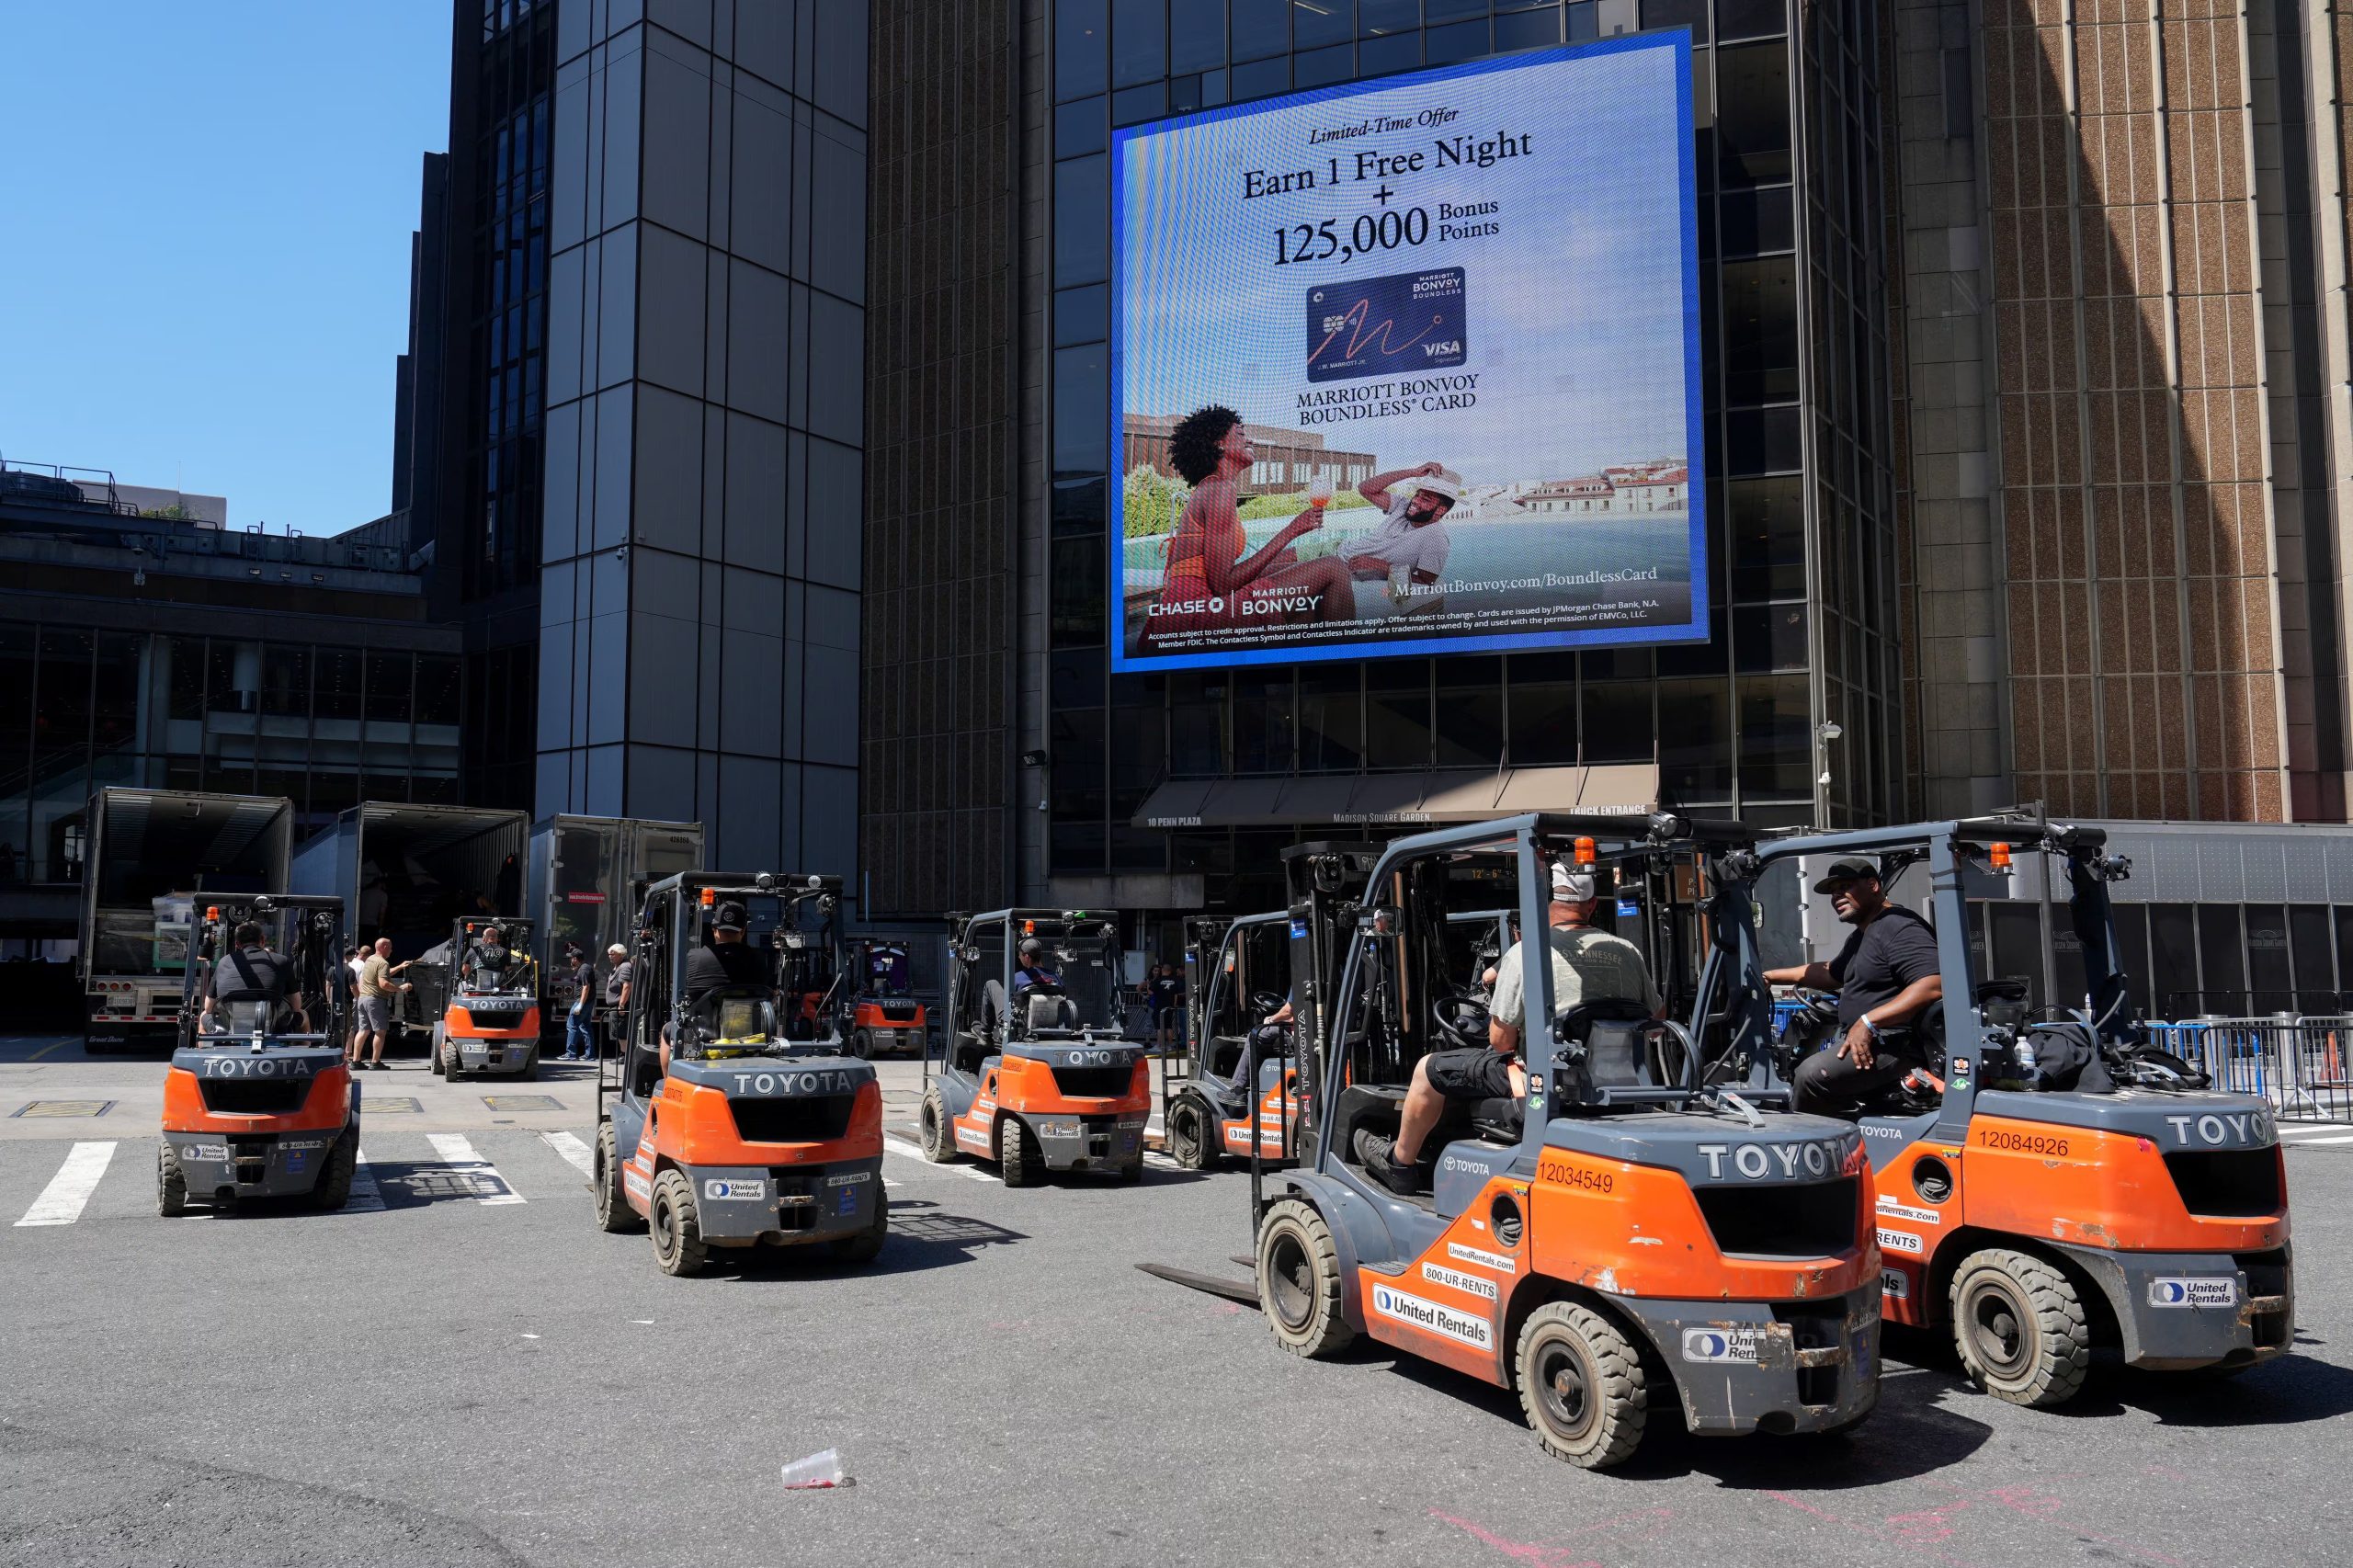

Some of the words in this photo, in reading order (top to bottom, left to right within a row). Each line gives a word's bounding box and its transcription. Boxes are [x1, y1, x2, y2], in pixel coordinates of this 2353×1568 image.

[1309, 117, 1412, 144] Limited-Time
[1418, 108, 1460, 128] Offer
[1243, 169, 1315, 199] Earn
[1328, 158, 1339, 185] 1
[1355, 151, 1424, 180] Free
[1435, 131, 1532, 168] Night
[1438, 201, 1499, 221] Bonus
[1274, 207, 1429, 265] 125,000
[1438, 221, 1500, 242] Points
[1413, 278, 1461, 292] BONVOY
[1413, 289, 1461, 299] BOUNDLESS
[1423, 340, 1461, 357] VISA
[1296, 383, 1395, 408] MARRIOTT
[1401, 373, 1479, 396] BONVOY
[1422, 392, 1476, 412] CARD
[1252, 585, 1310, 597] MARRIOTT
[1394, 567, 1658, 597] MarriottBonvoy.com/BoundlessCard
[1149, 599, 1206, 617] CHASE
[1242, 597, 1321, 615] BONVOY
[1148, 631, 1178, 641] Accounts
[1179, 630, 1203, 639] subject
[1213, 627, 1233, 635] credit
[1234, 625, 1267, 635] approval.
[1267, 622, 1309, 631] Restrictions
[1324, 619, 1363, 628] limitations
[1365, 618, 1387, 627] apply.
[1409, 614, 1435, 623] subject
[1447, 611, 1476, 621] change.
[1478, 609, 1500, 618] Cards
[1516, 607, 1540, 615] issued
[1541, 606, 1552, 615] by
[1552, 604, 1591, 614] JPMorgan
[1592, 602, 1617, 611] Chase
[1618, 601, 1641, 609] Bank,
[1158, 641, 1187, 649] Member
[1206, 637, 1219, 645] The
[1220, 634, 1259, 644] Contactless
[1260, 632, 1286, 642] Symbol
[1288, 631, 1301, 640] and
[1302, 630, 1343, 639] Contactless
[1344, 627, 1377, 636] Indicator
[1392, 623, 1435, 633] trademarks
[1436, 621, 1462, 631] owned
[1463, 621, 1472, 631] by
[1474, 619, 1489, 628] and
[1491, 618, 1509, 627] used
[1510, 617, 1528, 625] with
[1529, 616, 1542, 624] the
[1543, 614, 1587, 625] permission
[1631, 610, 1647, 619] LLC.
[1333, 813, 1367, 823] MADISON
[1369, 812, 1398, 823] SQUARE
[1570, 806, 1599, 815] TRUCK
[1601, 804, 1646, 815] ENTRANCE
[1147, 817, 1156, 827] 10
[1157, 816, 1176, 827] PENN
[1177, 816, 1201, 826] PLAZA
[1575, 949, 1622, 965] TENNESSEE
[472, 1000, 524, 1010] TOYOTA
[1054, 1051, 1131, 1066] TOYOTA
[1297, 1009, 1310, 1090] TOYOTA
[203, 1058, 309, 1077] TOYOTA
[733, 1071, 853, 1095] TOYOTA
[1238, 1131, 1252, 1140] Unit
[1859, 1125, 1903, 1140] TOYOTA
[1979, 1131, 2068, 1156] 12084926
[1456, 1158, 1490, 1176] TOYOTA
[1697, 1138, 1860, 1181] TOYOTA
[1540, 1162, 1613, 1193] 12034549
[1876, 1233, 1917, 1249] RENTS
[1449, 1244, 1515, 1271] UnitedRentals.com
[1426, 1267, 1495, 1298] 800-UR-RENTS
[2187, 1282, 2227, 1293] United
[2187, 1293, 2231, 1303] Rentals
[1393, 1295, 1434, 1324] United
[1437, 1310, 1486, 1342] Rentals
